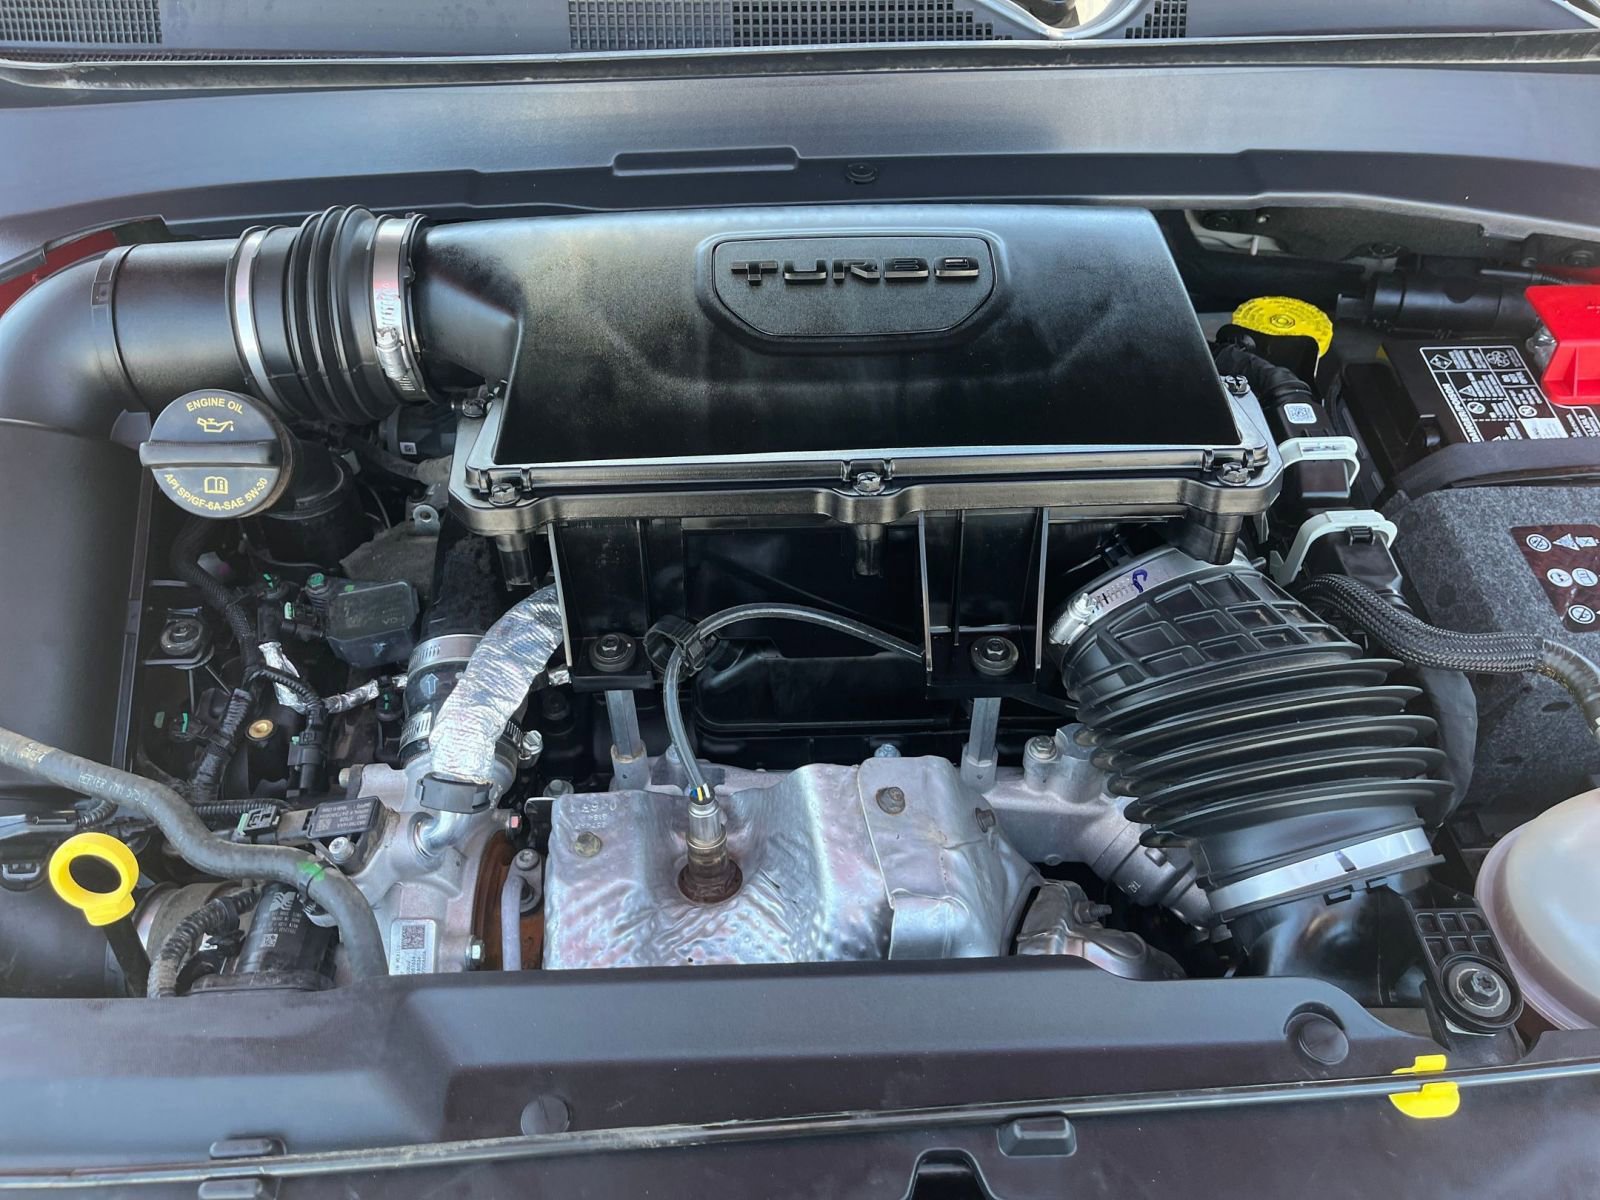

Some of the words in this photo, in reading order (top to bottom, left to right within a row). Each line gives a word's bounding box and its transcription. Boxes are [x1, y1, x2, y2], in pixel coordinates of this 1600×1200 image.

[731, 256, 980, 282] TURBO
[186, 397, 225, 412] ENGINE
[227, 400, 244, 415] OIL
[165, 473, 178, 489] API
[245, 478, 268, 501] 5W-30
